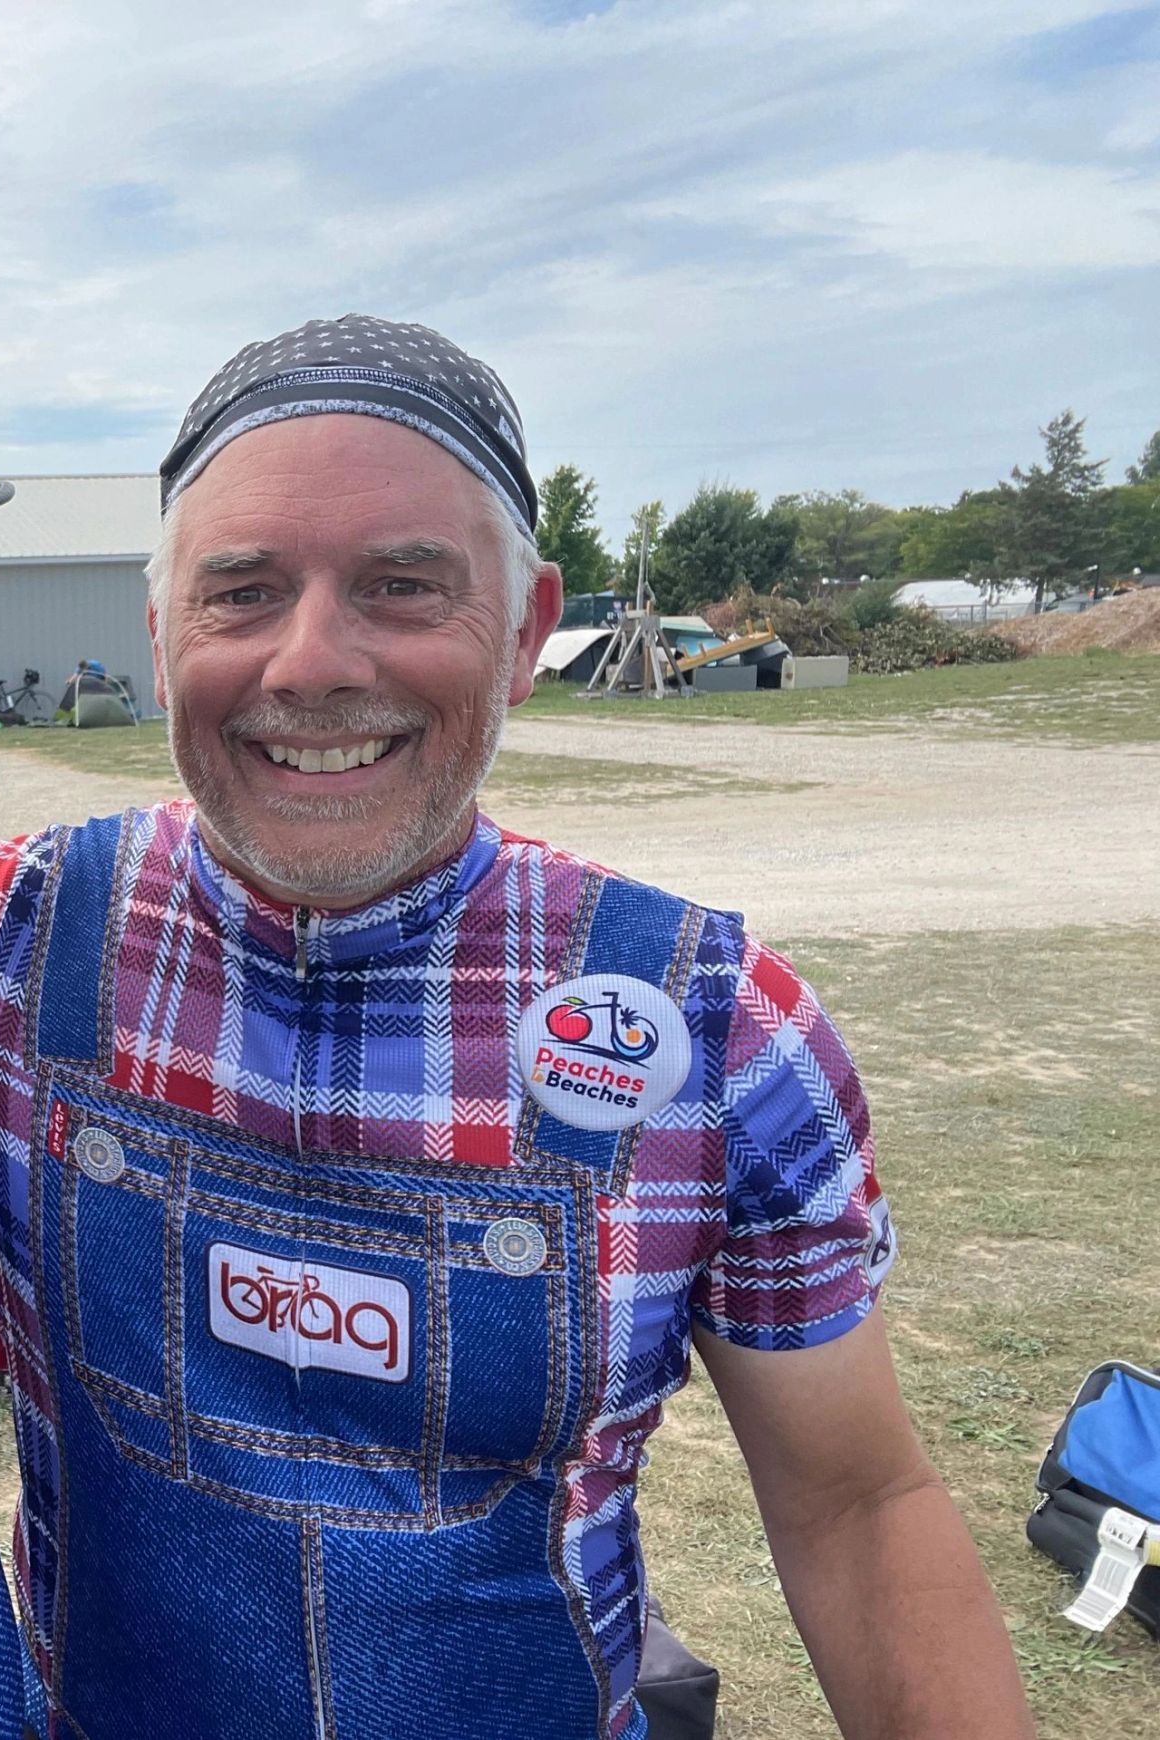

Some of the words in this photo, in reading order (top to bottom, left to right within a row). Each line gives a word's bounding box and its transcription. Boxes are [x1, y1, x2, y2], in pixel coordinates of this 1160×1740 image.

[535, 1047, 646, 1093] Peaches
[545, 1070, 639, 1108] Beaches
[220, 1261, 399, 1370] brag
